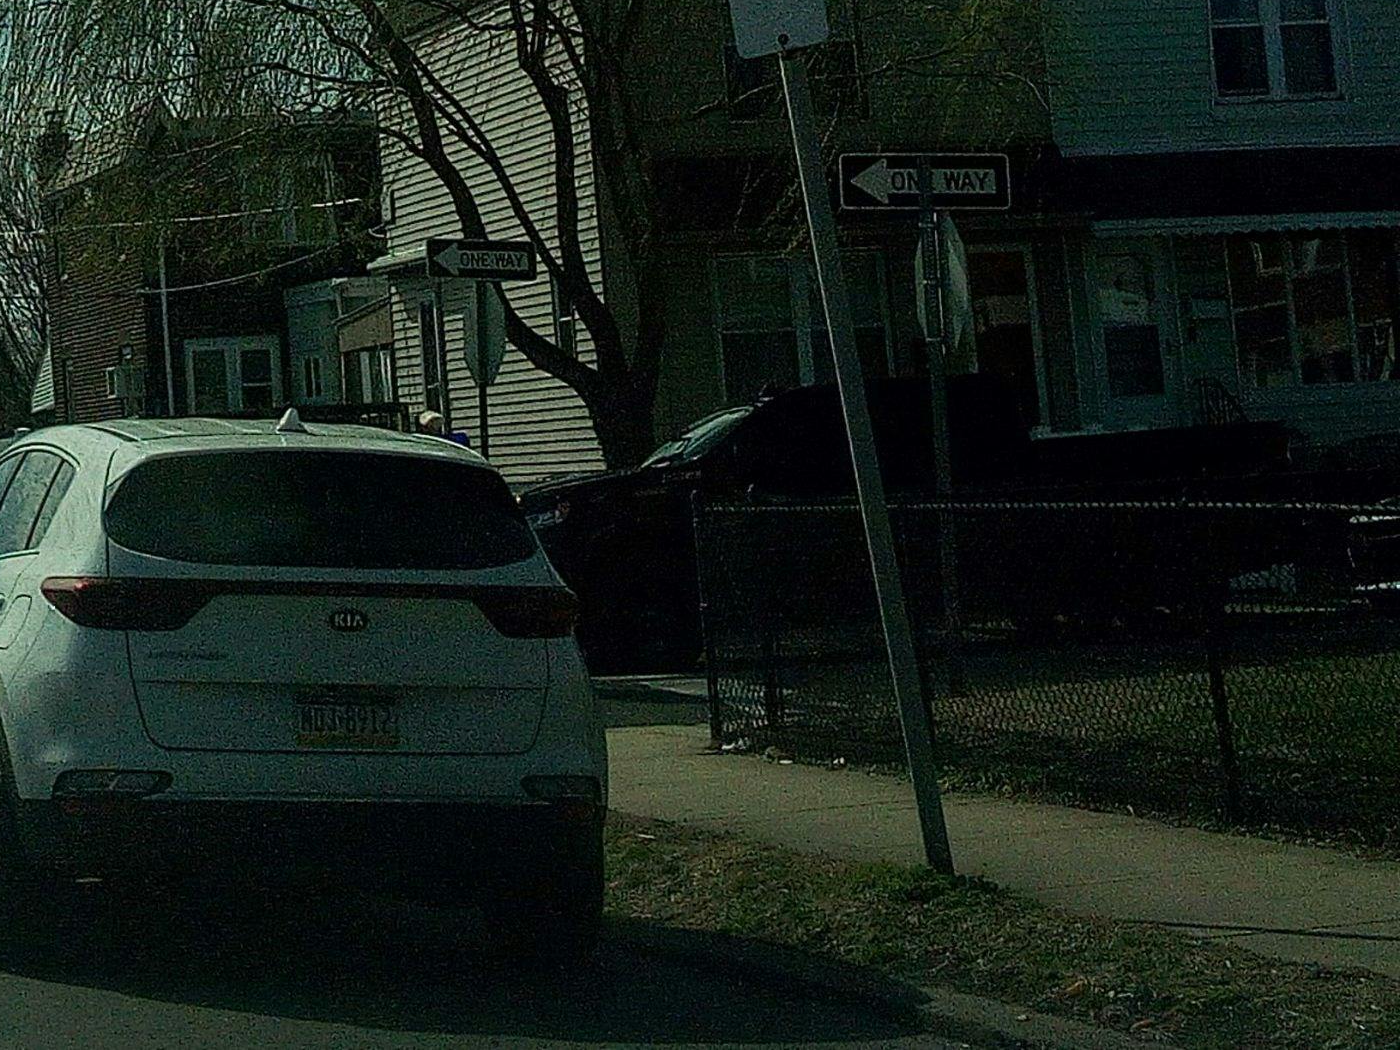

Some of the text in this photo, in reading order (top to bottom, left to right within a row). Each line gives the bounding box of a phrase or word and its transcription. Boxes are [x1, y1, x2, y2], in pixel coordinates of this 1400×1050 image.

[943, 171, 990, 192] WAY
[460, 252, 525, 268] ONE WAY
[334, 612, 364, 627] KIA
